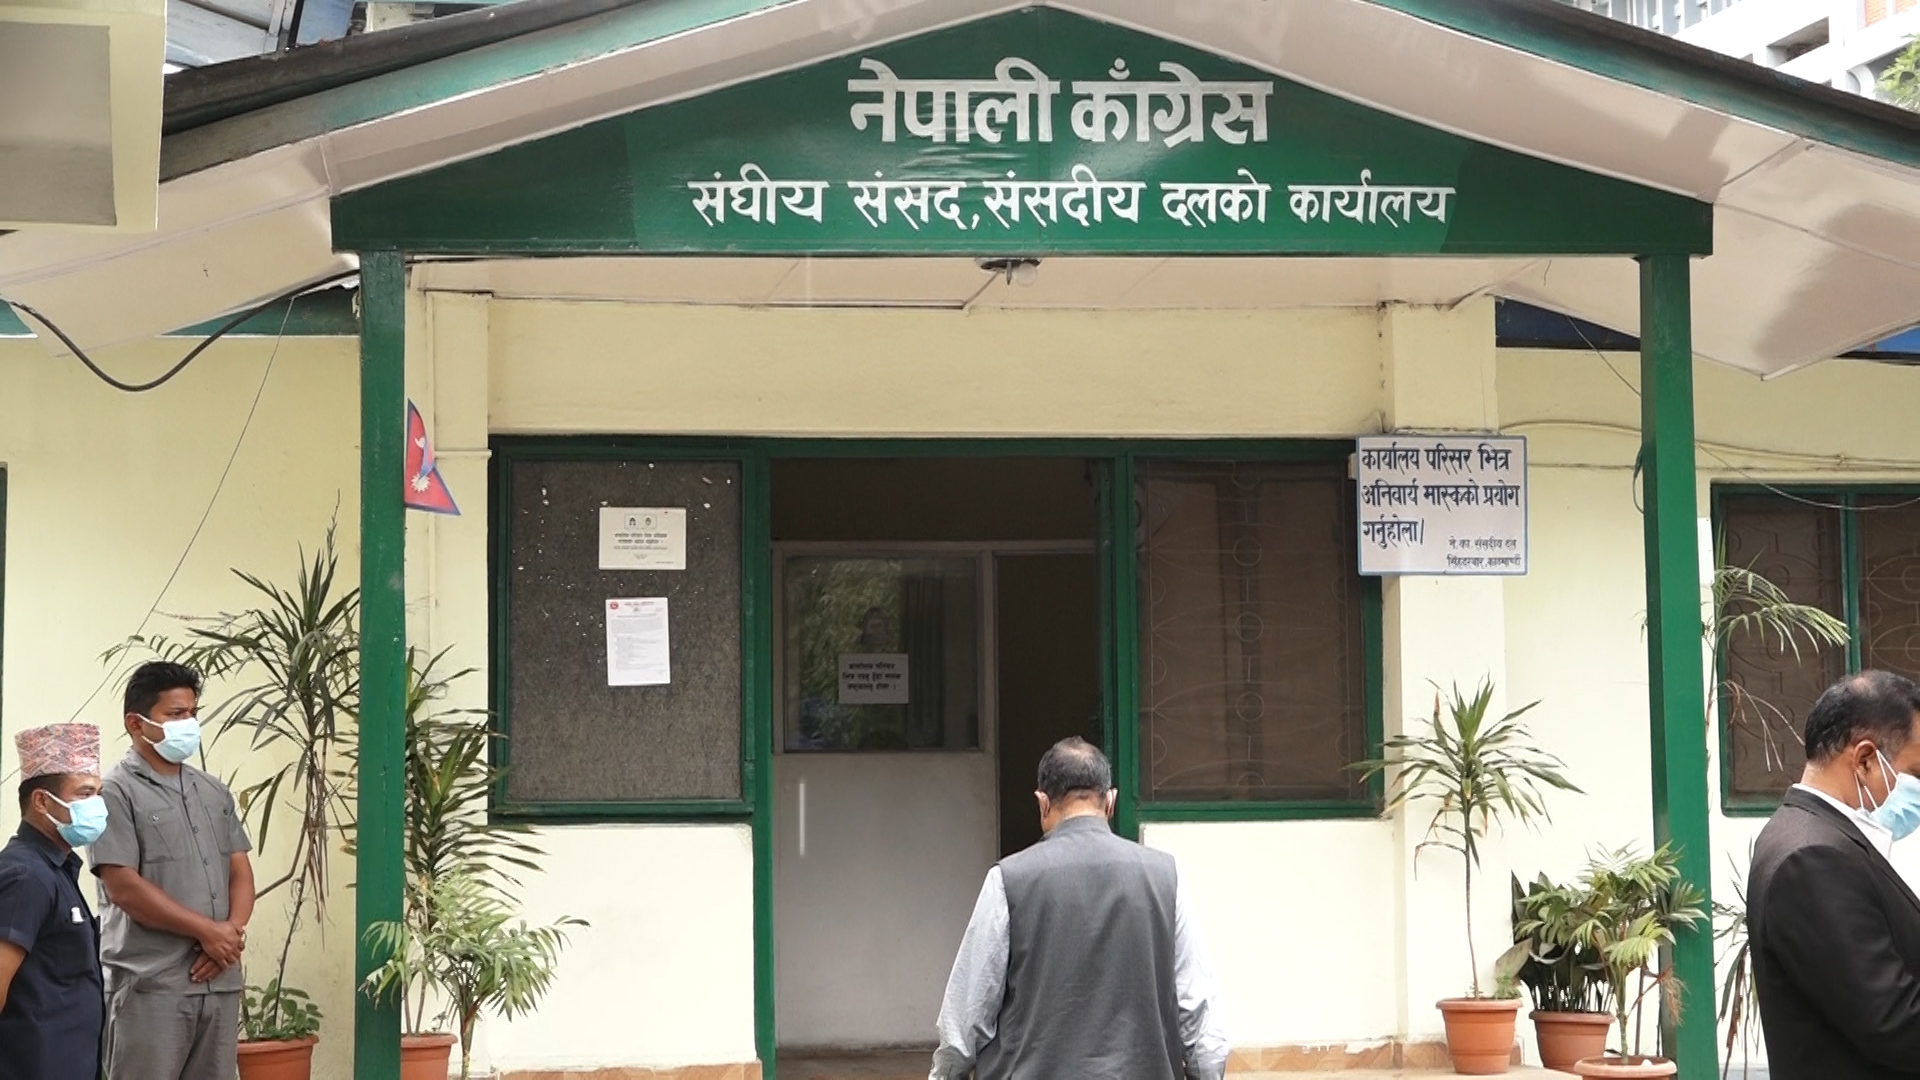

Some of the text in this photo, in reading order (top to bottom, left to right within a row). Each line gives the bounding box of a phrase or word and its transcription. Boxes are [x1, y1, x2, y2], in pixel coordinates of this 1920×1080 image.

[848, 57, 1274, 148] नेपाली काँग्रेस
[688, 163, 830, 228] संघीय
[1160, 168, 1272, 228] दलको
[1287, 168, 1456, 228] कार्यालय
[1362, 441, 1512, 475] कार्यालय परिसर भित्र
[1361, 478, 1521, 512] अनिवार्य मास्कको प्रयोग
